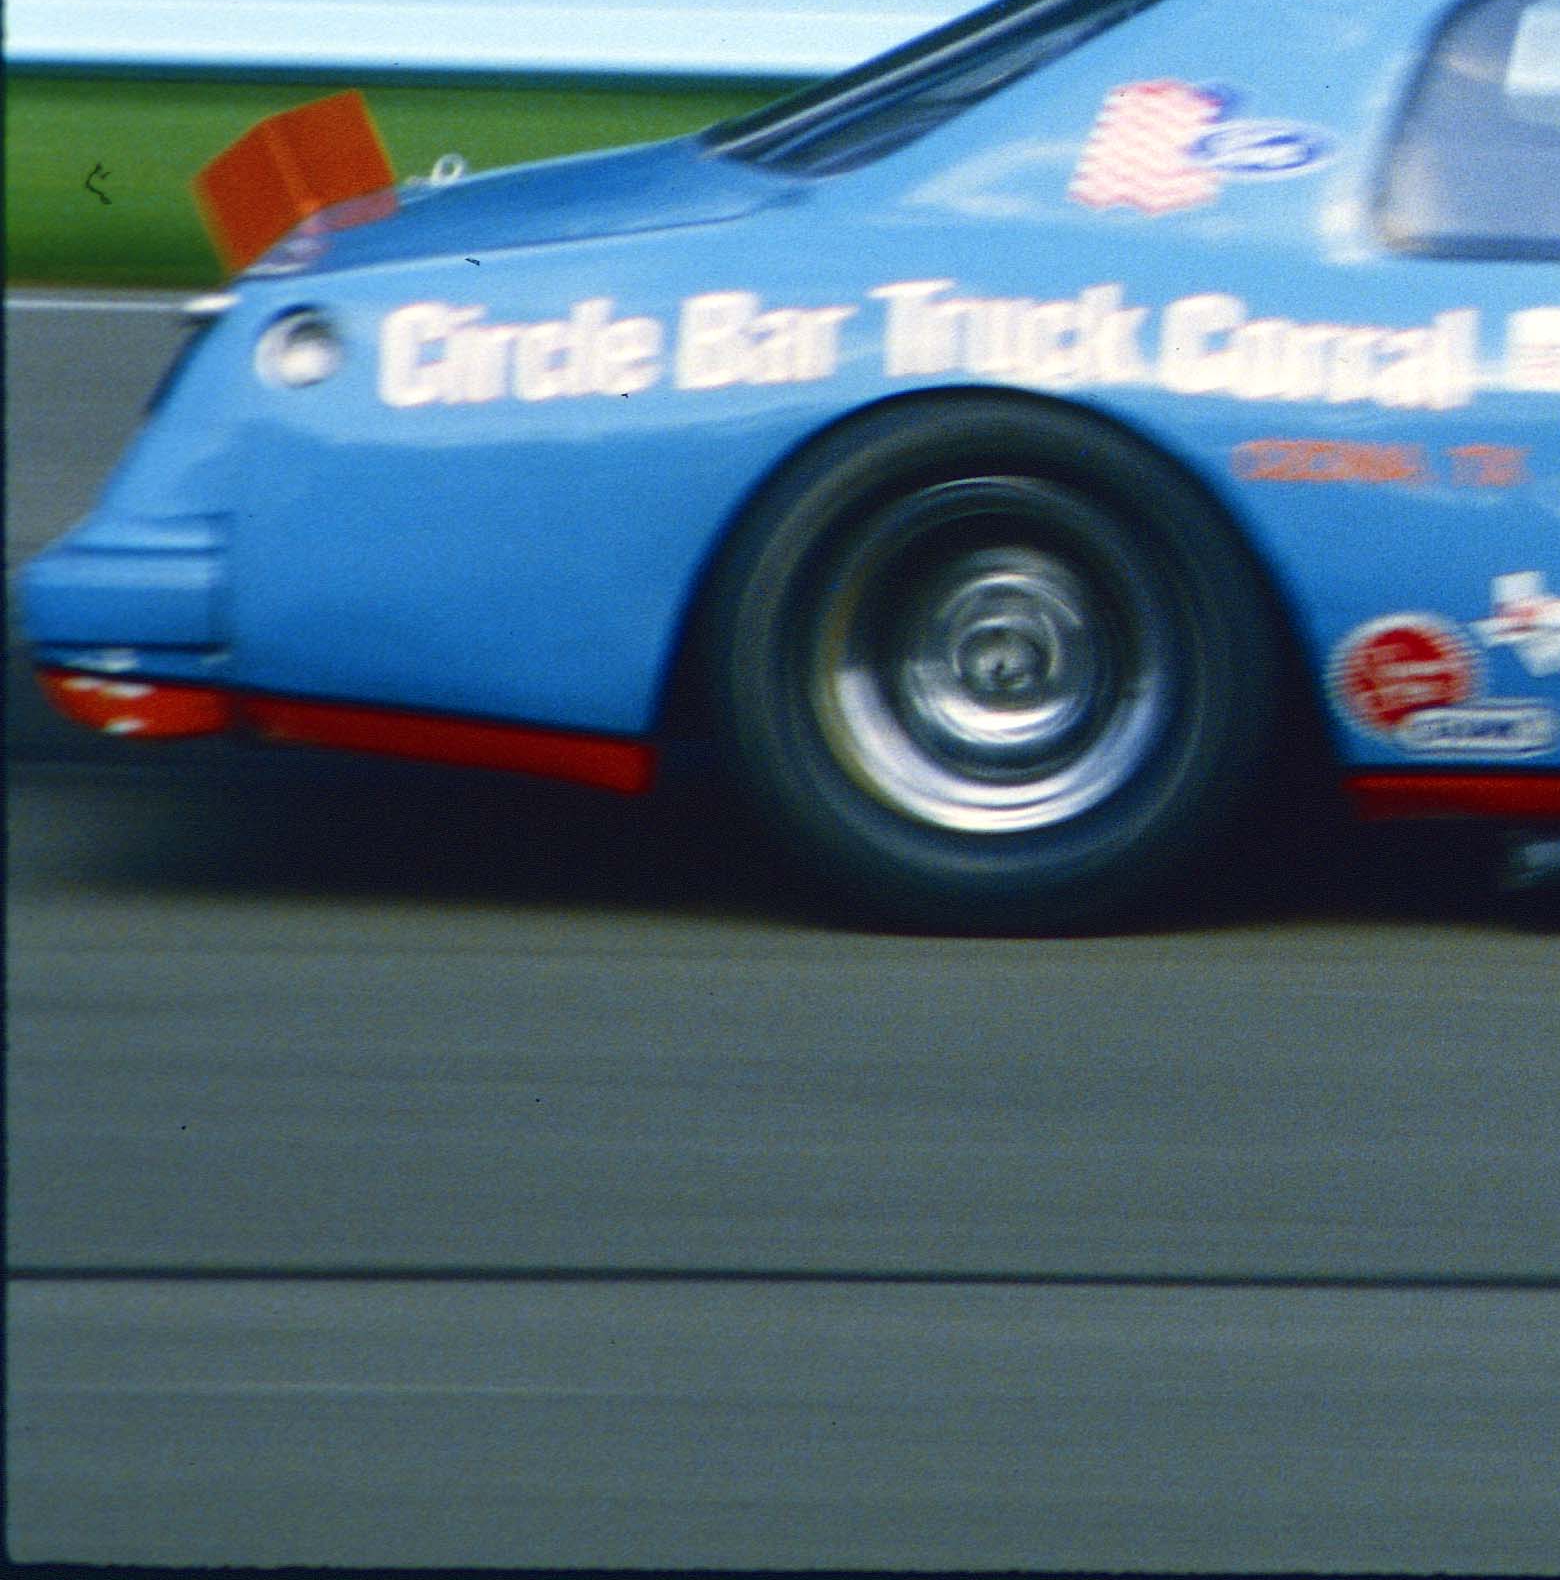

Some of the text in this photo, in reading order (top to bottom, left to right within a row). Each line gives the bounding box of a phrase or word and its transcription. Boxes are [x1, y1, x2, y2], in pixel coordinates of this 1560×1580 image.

[380, 297, 661, 406] Circle
[675, 291, 857, 389] Bar
[867, 279, 1149, 382] Truck
[1161, 293, 1480, 410] Corral
